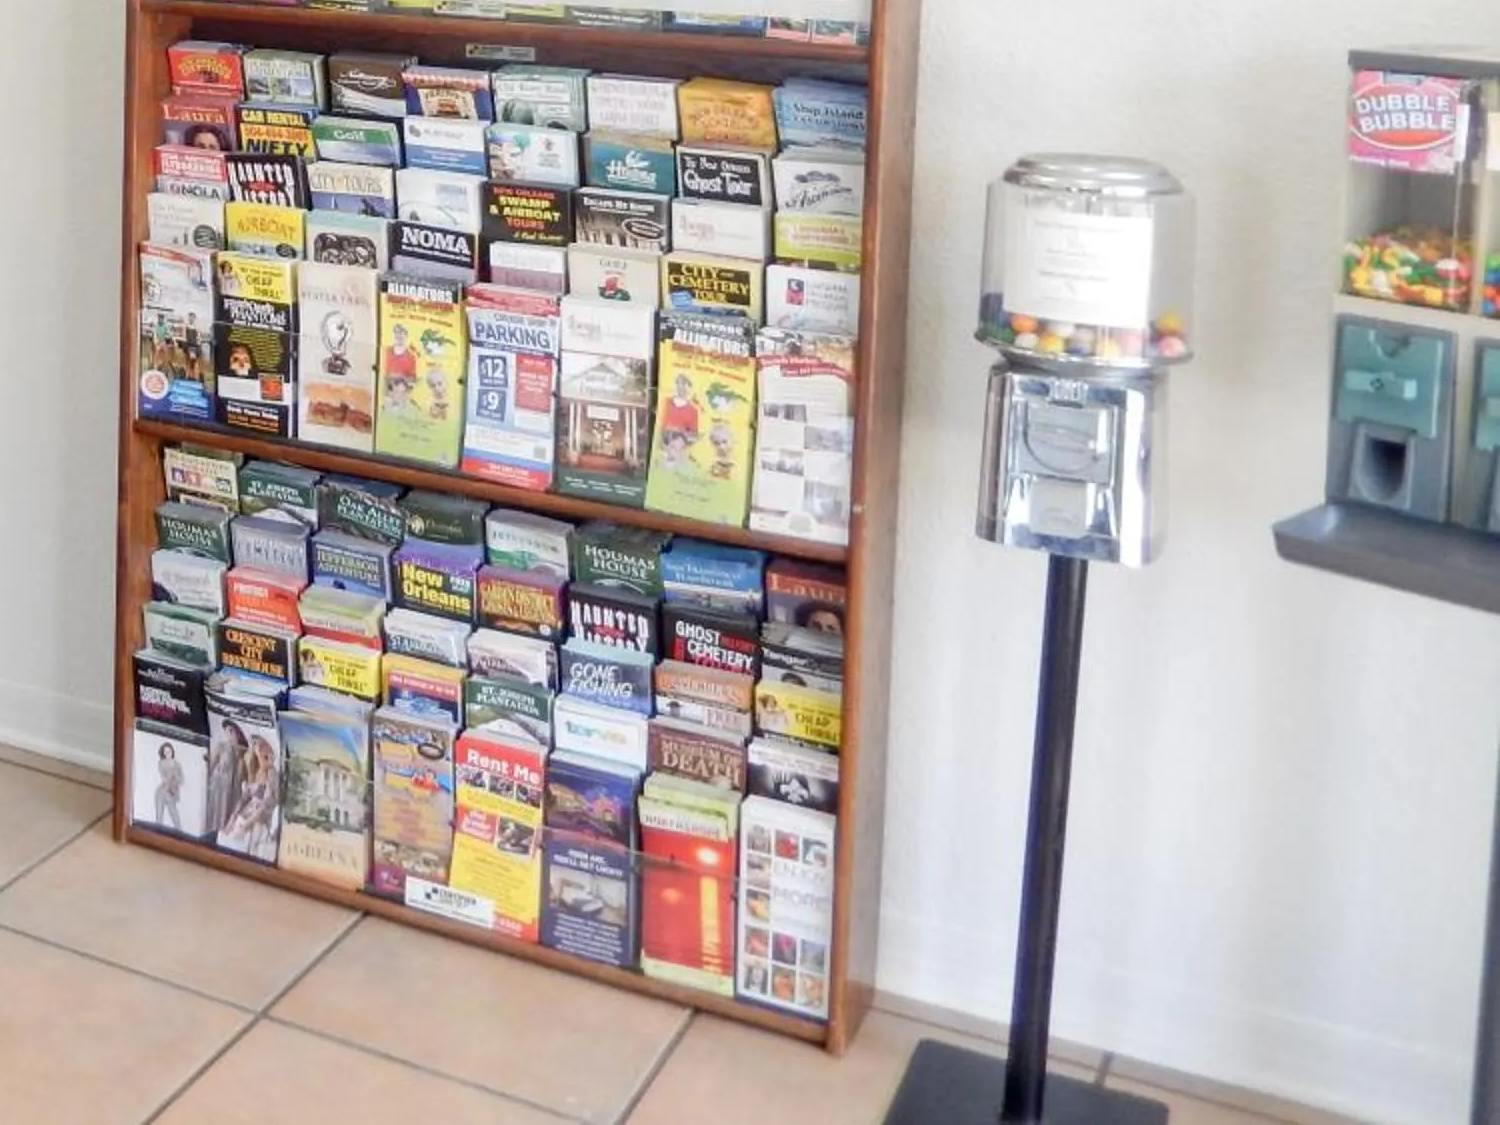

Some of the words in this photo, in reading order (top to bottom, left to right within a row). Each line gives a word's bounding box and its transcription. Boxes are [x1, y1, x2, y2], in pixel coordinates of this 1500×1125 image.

[162, 104, 226, 125] Laura
[1355, 93, 1451, 114] DUBBLE
[241, 110, 265, 124] CAR
[1359, 111, 1456, 134] BUBBLE
[333, 129, 366, 142] Golf
[227, 162, 295, 189] HAUNTED
[683, 169, 723, 195] Ghost
[720, 172, 753, 196] Tour
[489, 203, 499, 215] &
[503, 206, 561, 223] AIRBOAT
[499, 195, 551, 209] SWAMP
[401, 226, 472, 255] NOMA
[681, 264, 721, 279] CITY
[387, 282, 454, 304] ALLIGATORS
[669, 275, 751, 296] CEMETERY
[475, 322, 551, 349] PARKING
[585, 544, 656, 571] HOUMAS
[593, 557, 648, 580] HOUSE
[402, 562, 444, 587] New
[402, 581, 471, 611] Orleans
[769, 572, 847, 603] Laura
[570, 600, 650, 639] HAUNTED
[226, 629, 277, 651] CRESCENT
[675, 620, 721, 646] GHOST
[687, 639, 755, 669] CEMETERY
[569, 662, 620, 679] GONE
[467, 748, 509, 775] Rent
[513, 762, 541, 785] Me
[662, 751, 741, 786] DEATH
